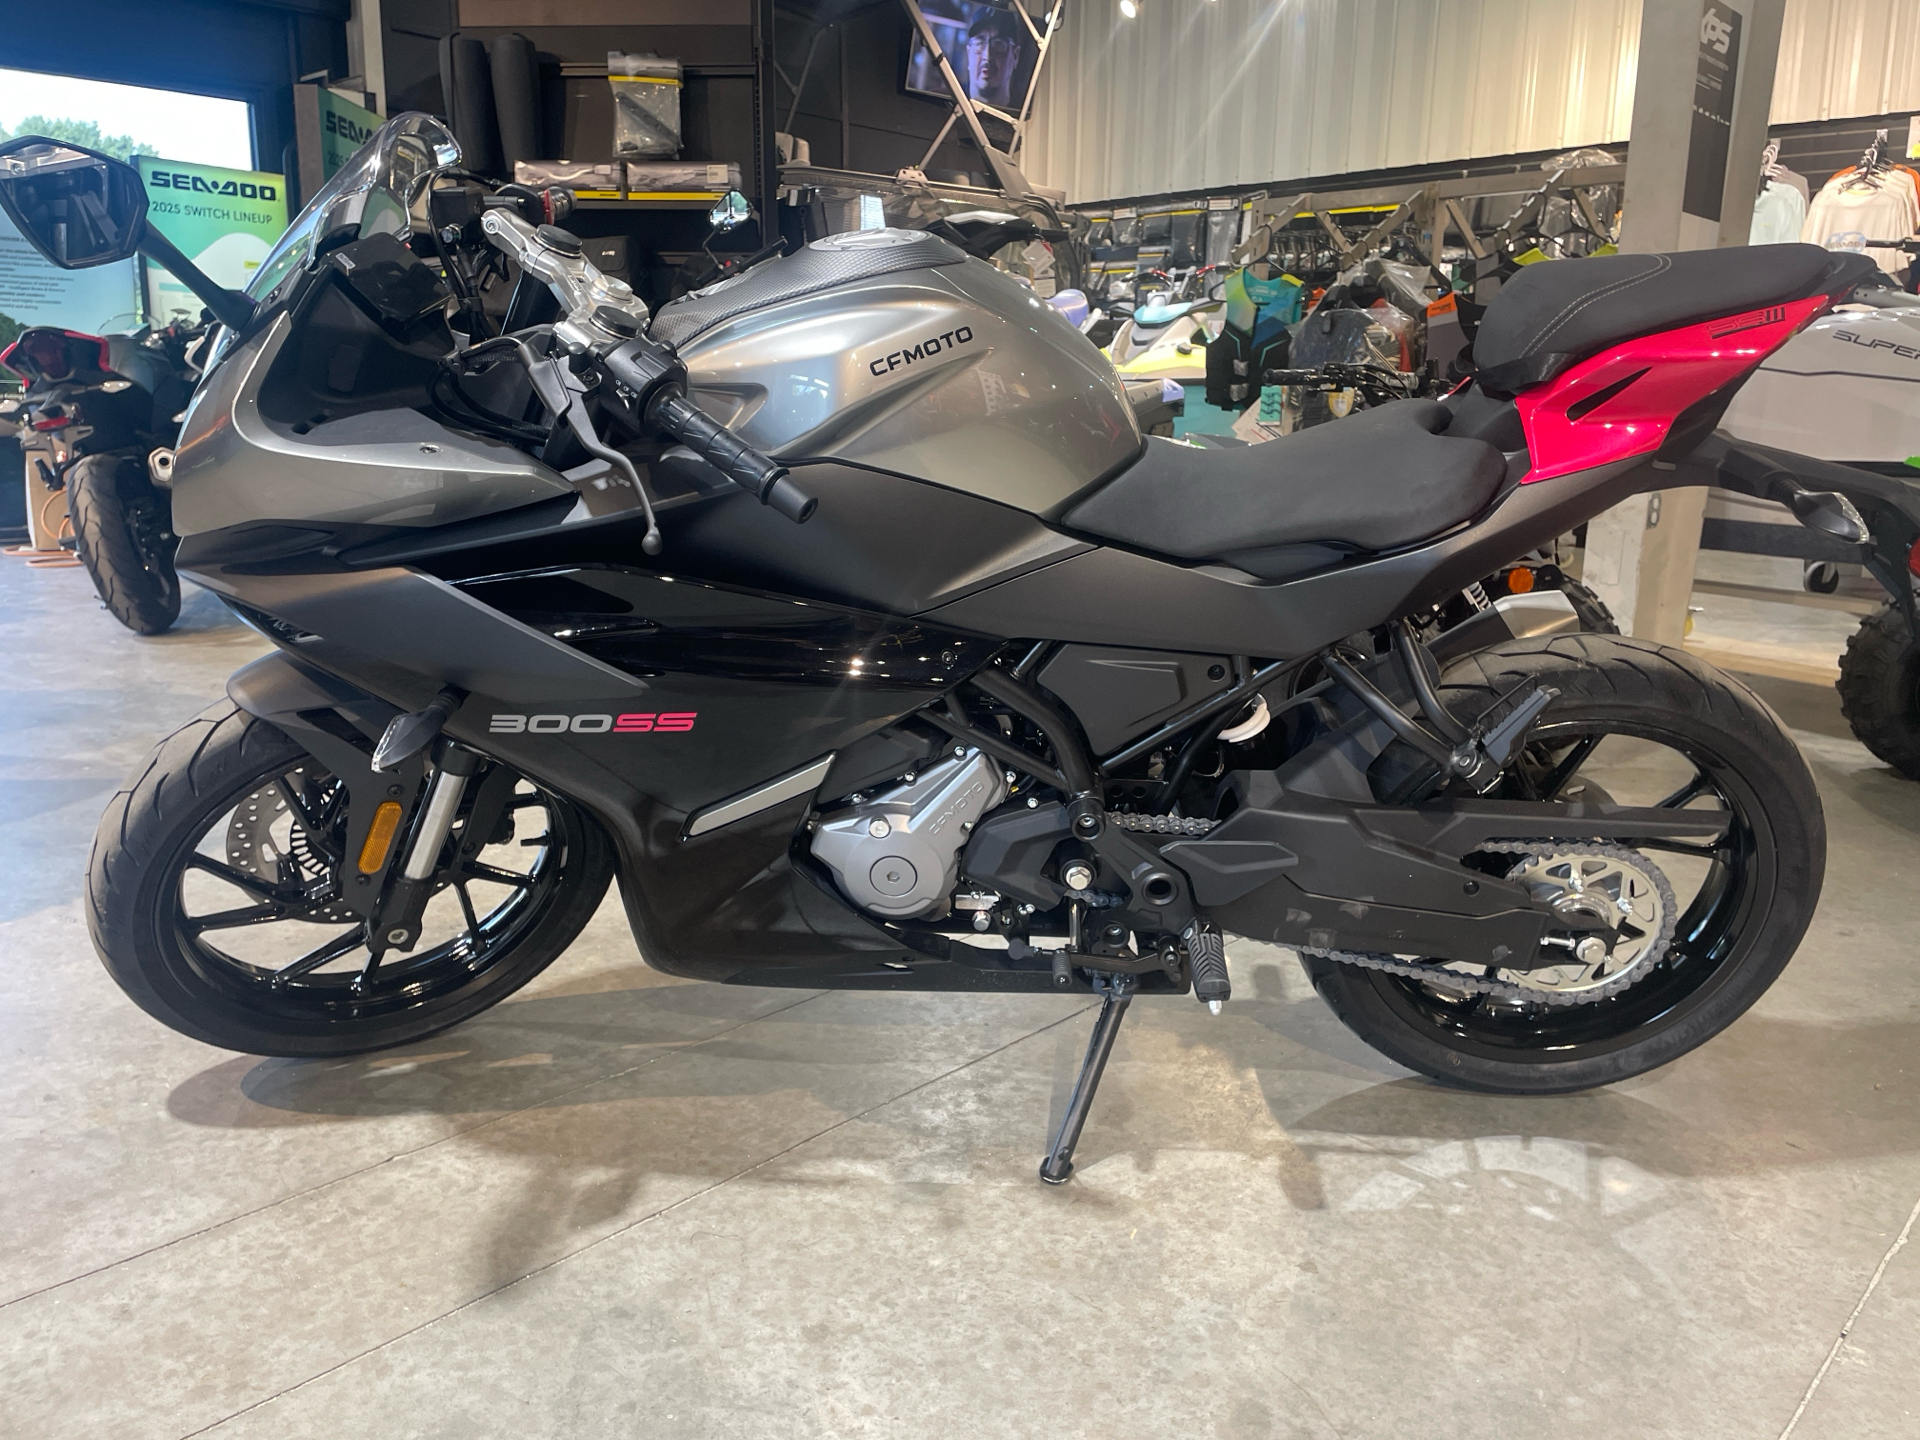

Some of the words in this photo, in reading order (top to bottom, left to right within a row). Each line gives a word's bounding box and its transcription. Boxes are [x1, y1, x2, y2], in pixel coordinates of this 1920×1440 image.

[152, 201, 181, 215] 2025
[184, 205, 230, 220] SWITCH
[233, 210, 273, 225] LINEUP
[869, 326, 973, 376] CFMOTO
[489, 712, 698, 734] 300SS
[929, 781, 985, 835] CFMOTO
